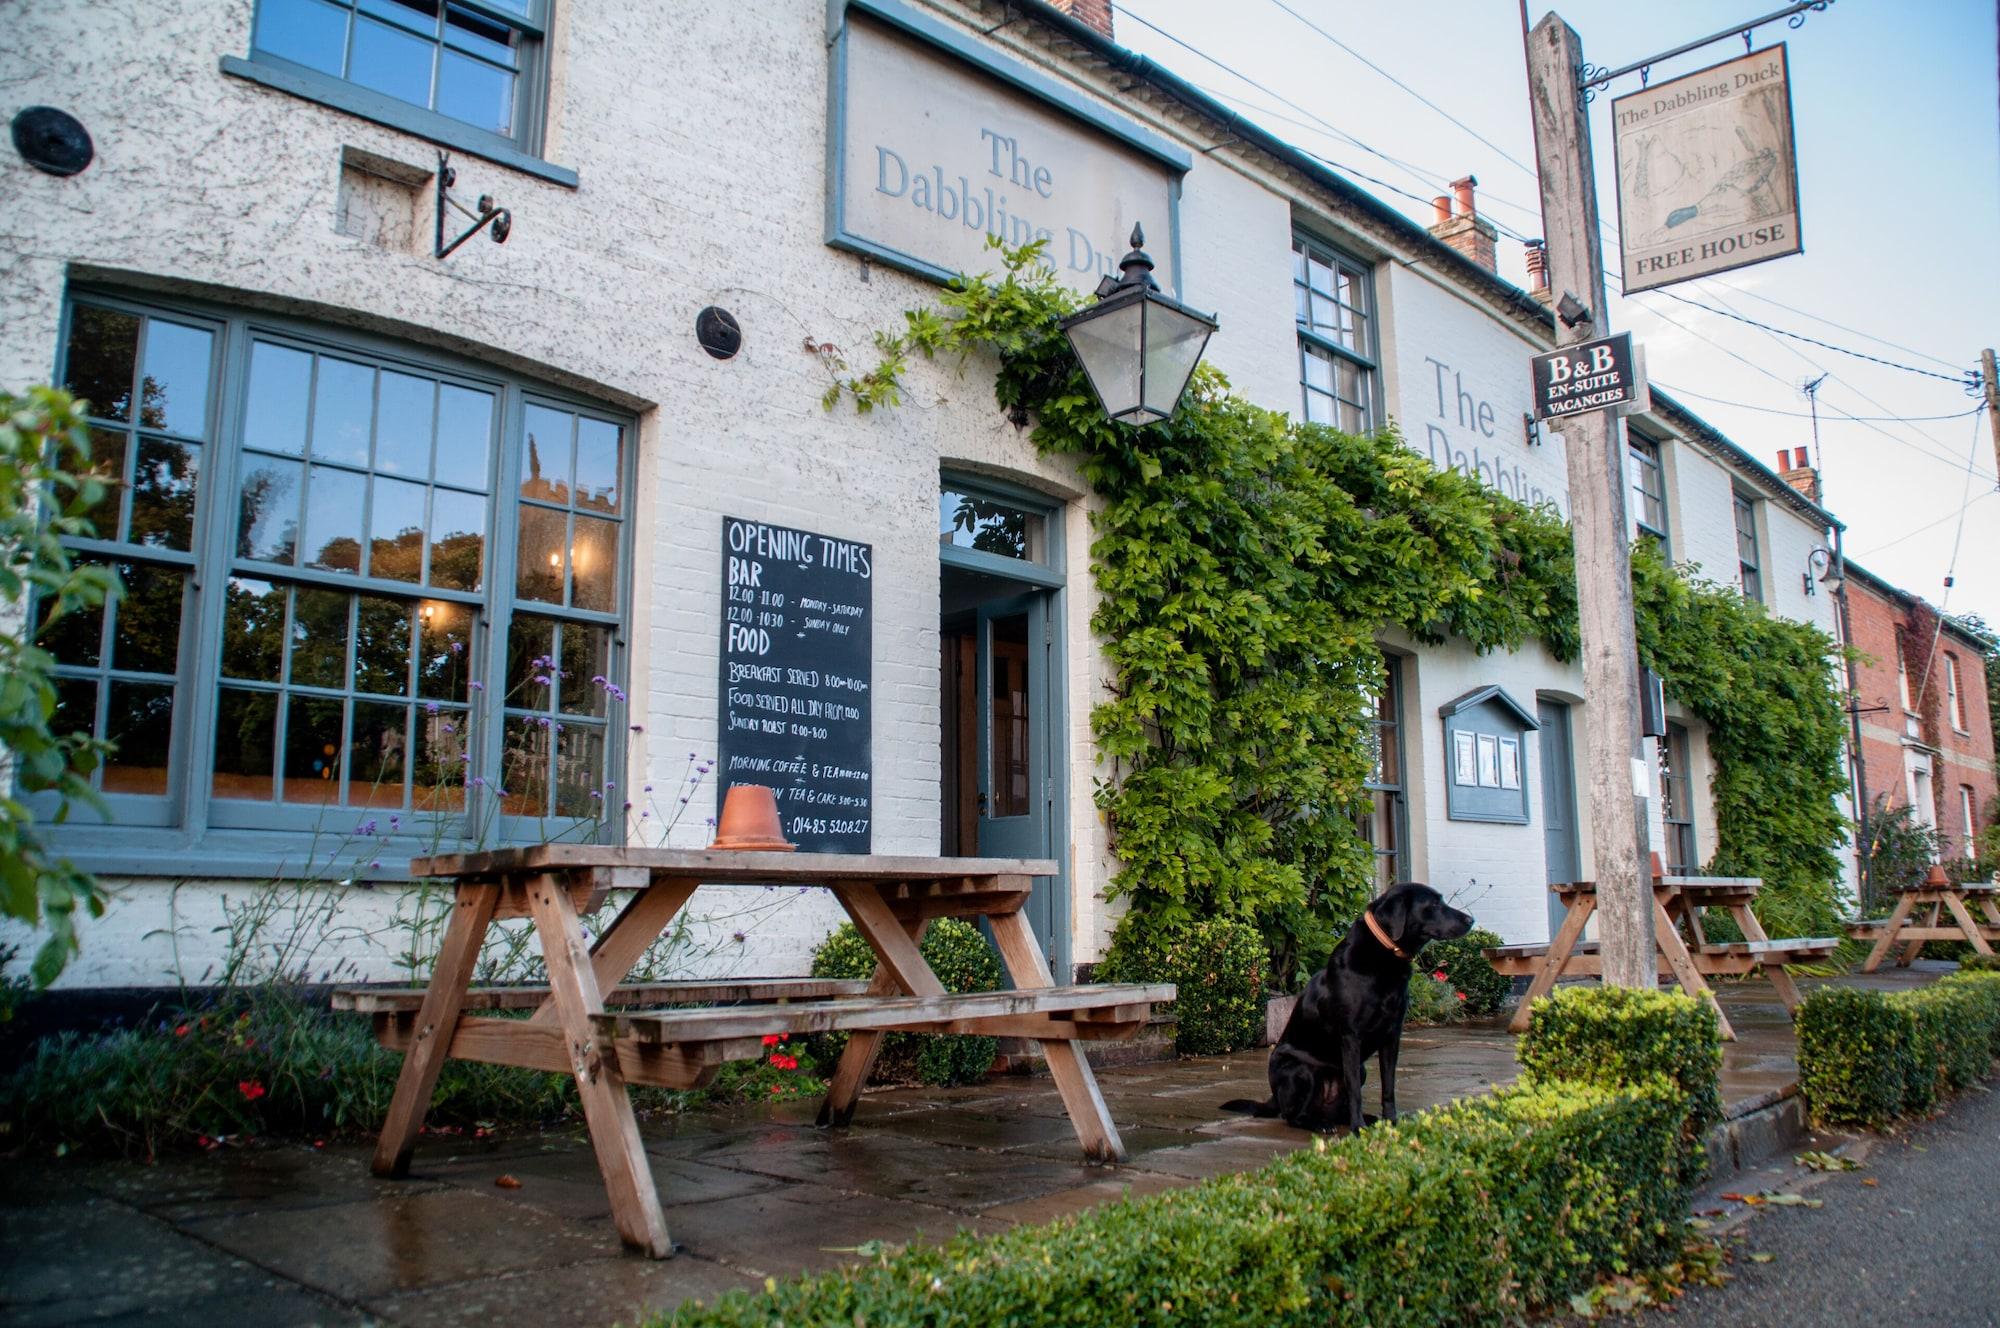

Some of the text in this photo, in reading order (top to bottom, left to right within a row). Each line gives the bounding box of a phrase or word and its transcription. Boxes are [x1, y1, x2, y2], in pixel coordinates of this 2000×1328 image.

[1618, 62, 1781, 127] The Dabbling Duck
[981, 127, 1053, 199] The
[1066, 225, 1117, 282] Du
[1636, 224, 1785, 276] FREE HOUSE
[1425, 356, 1494, 438] The
[1549, 371, 1620, 399] EN-SUITE
[1549, 388, 1624, 414] VACANCIES
[729, 521, 871, 578] OPENING TIMES
[729, 556, 762, 587] BAR
[728, 623, 769, 655] FOOD
[832, 624, 849, 636] ONLY
[728, 662, 782, 683] BREAKFAST
[786, 668, 819, 688] SERVED
[755, 693, 789, 714] SERVED
[790, 698, 806, 715] ALL
[808, 700, 823, 718] DAY
[824, 702, 845, 720] FROM
[761, 719, 786, 735] ROAST
[729, 755, 771, 772] MORNING
[773, 760, 807, 775] COFFEE
[812, 764, 819, 778] &
[822, 765, 839, 779] TEA
[789, 787, 805, 800] TEA
[807, 789, 815, 804] &
[817, 792, 836, 806] CAKE
[829, 819, 868, 835] 520827
